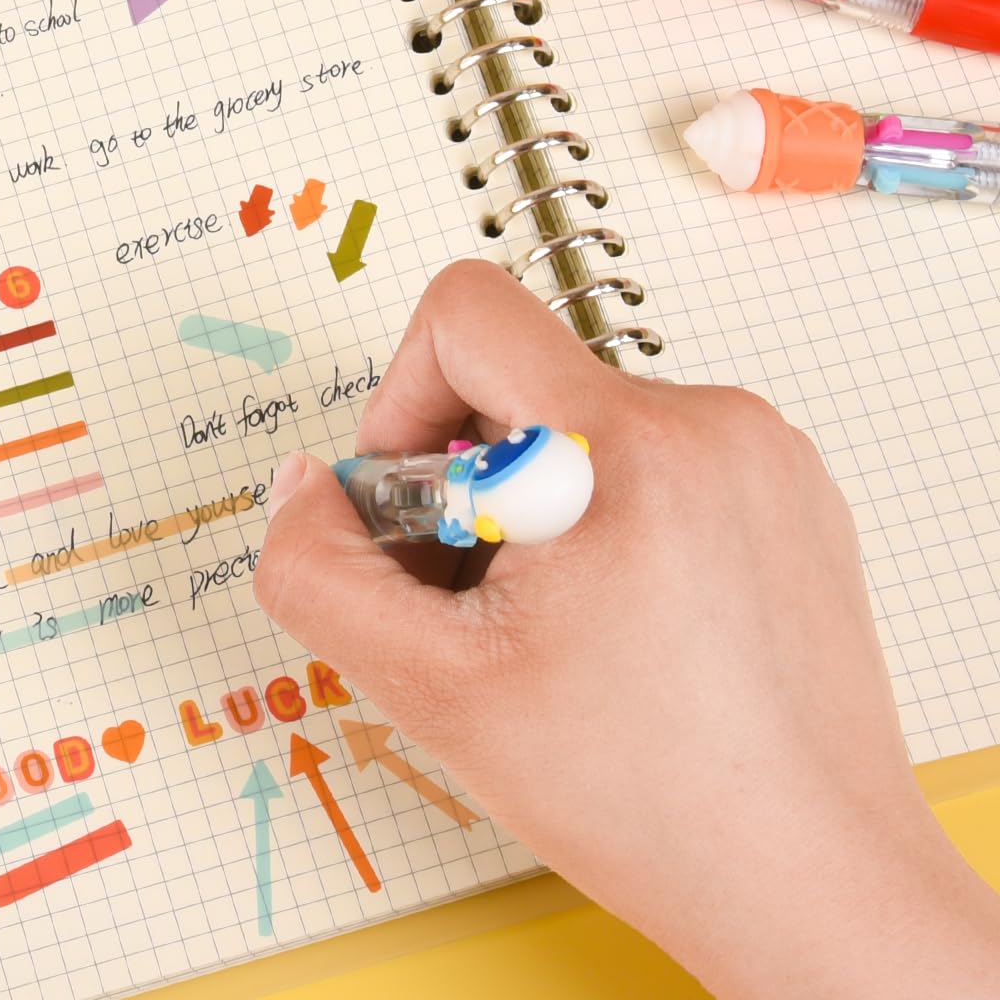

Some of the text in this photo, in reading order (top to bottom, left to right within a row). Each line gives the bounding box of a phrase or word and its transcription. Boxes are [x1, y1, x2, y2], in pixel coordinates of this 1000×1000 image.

[89, 134, 119, 168] go
[130, 127, 152, 148] to
[163, 100, 198, 138] the
[213, 79, 283, 134] grocery
[115, 212, 224, 264] exercise
[180, 410, 227, 448] Don't
[31, 527, 84, 575] and
[108, 511, 164, 550] love
[98, 583, 160, 626] more
[178, 659, 353, 748] LUCK
